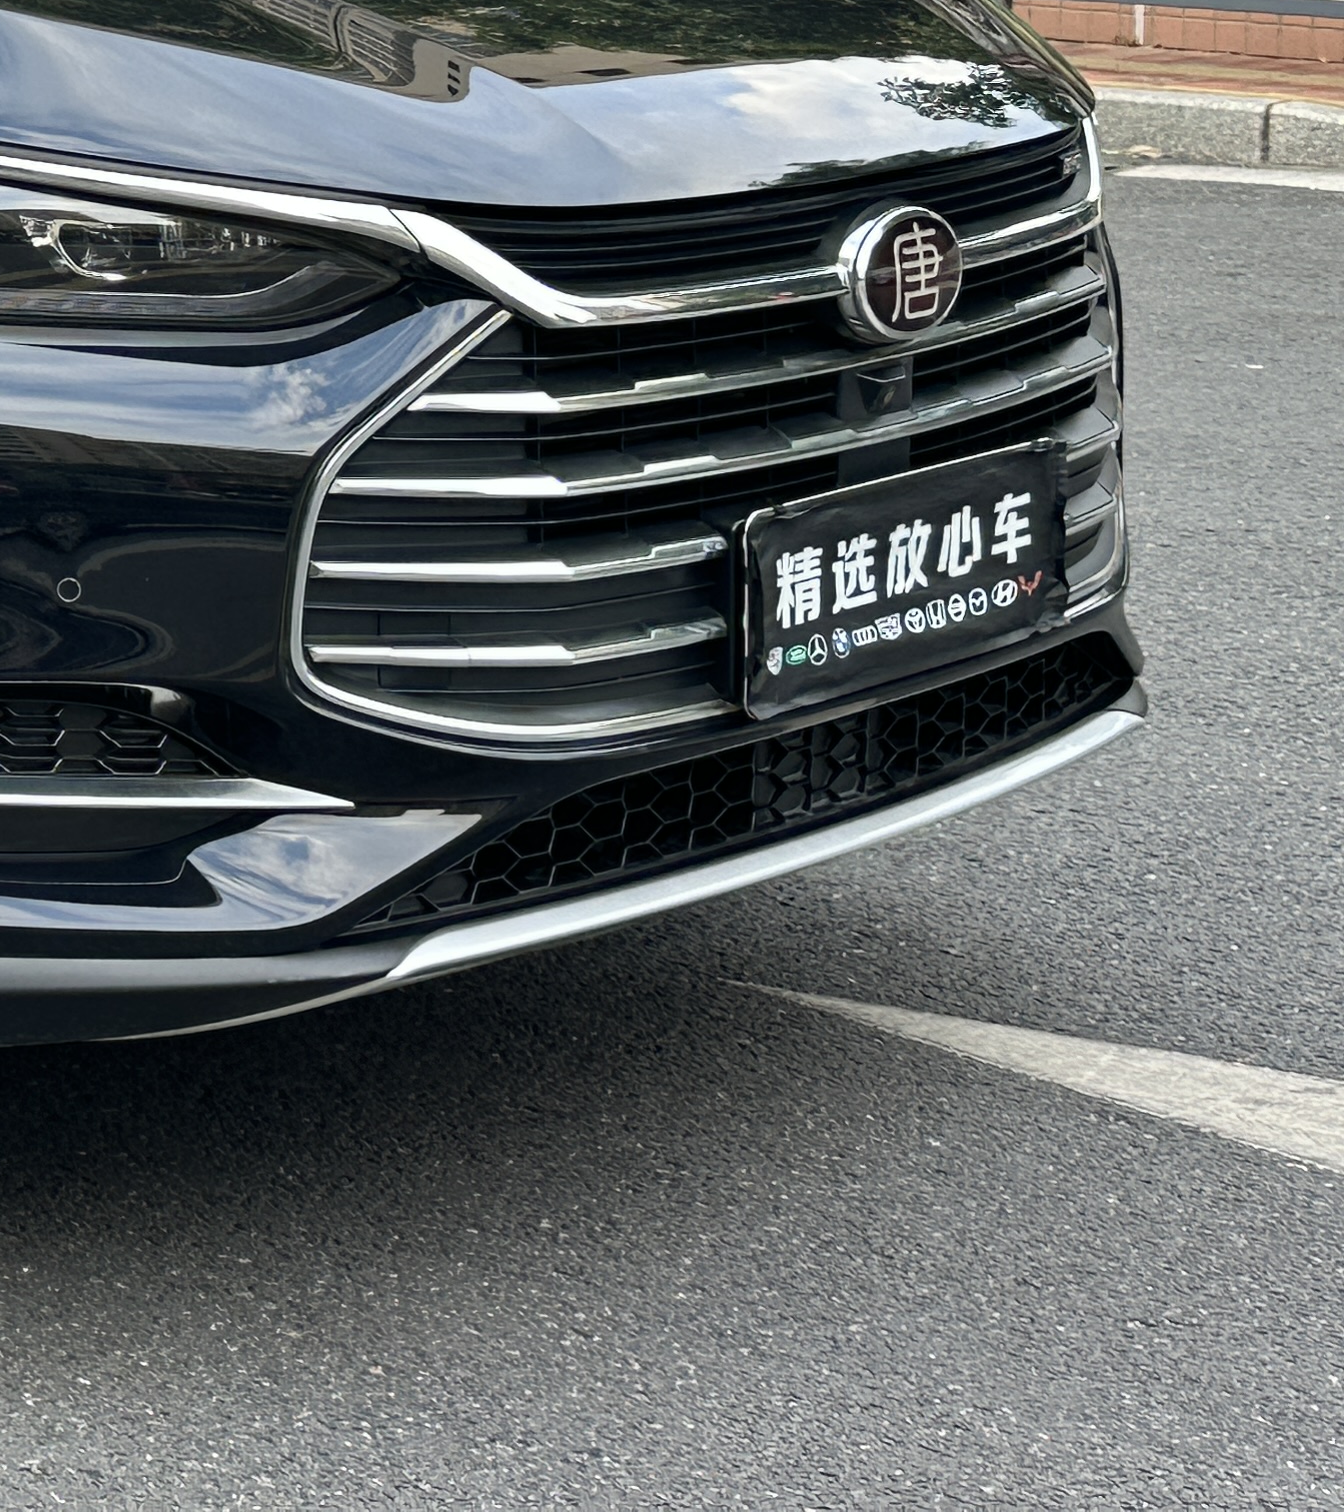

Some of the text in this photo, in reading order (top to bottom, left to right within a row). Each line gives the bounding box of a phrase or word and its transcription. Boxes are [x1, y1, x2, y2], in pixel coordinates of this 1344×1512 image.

[891, 221, 944, 323] 唐
[776, 492, 1032, 629] 精选放心车
